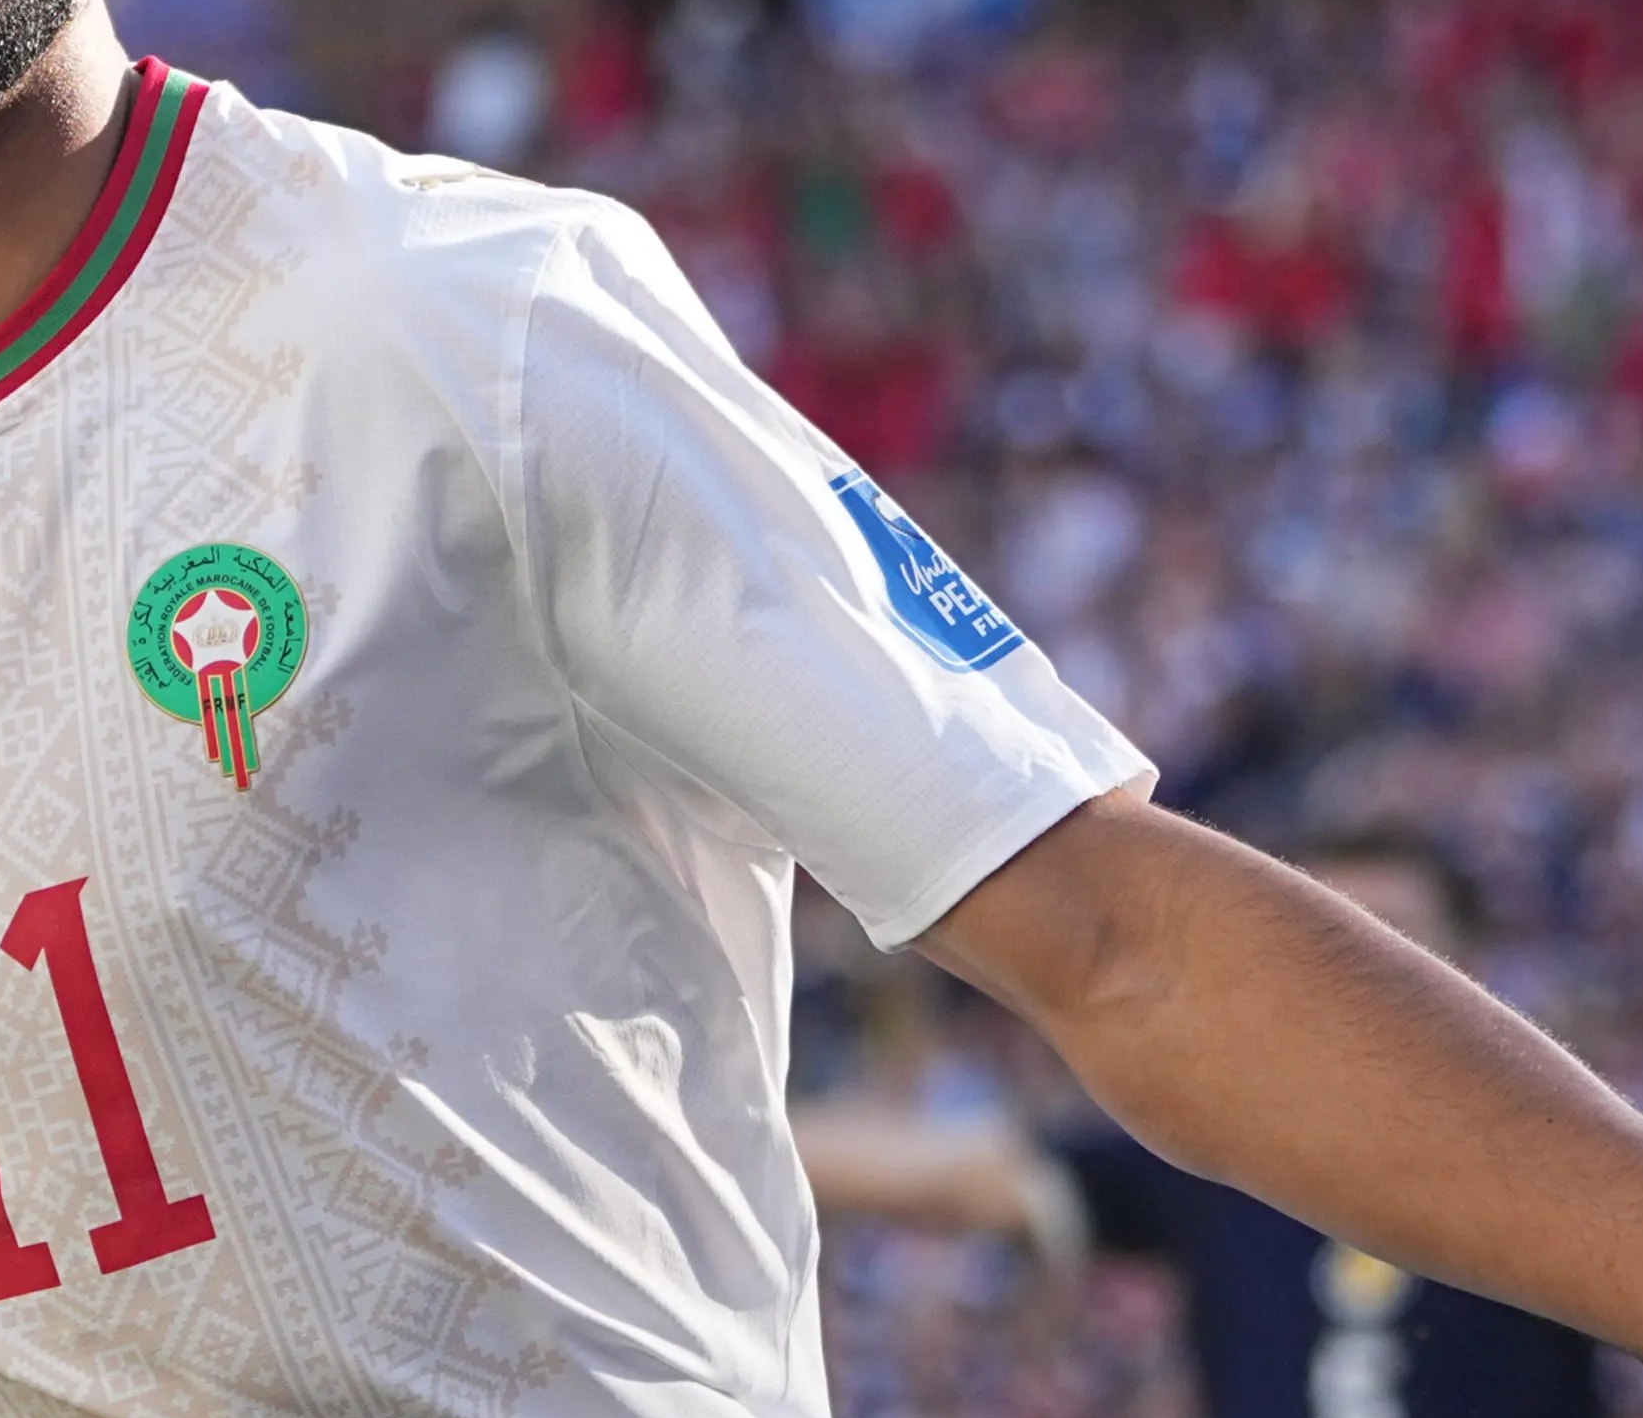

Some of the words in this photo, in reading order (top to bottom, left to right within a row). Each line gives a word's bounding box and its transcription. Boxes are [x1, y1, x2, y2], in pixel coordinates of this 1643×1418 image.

[147, 547, 220, 594] المغربية
[196, 574, 261, 598] MAROCAINE
[233, 547, 288, 593] الملكية
[161, 583, 194, 621] ROYALE
[258, 598, 271, 613] DE
[249, 615, 275, 673] FOOTBALL
[277, 599, 301, 674] الجامعة
